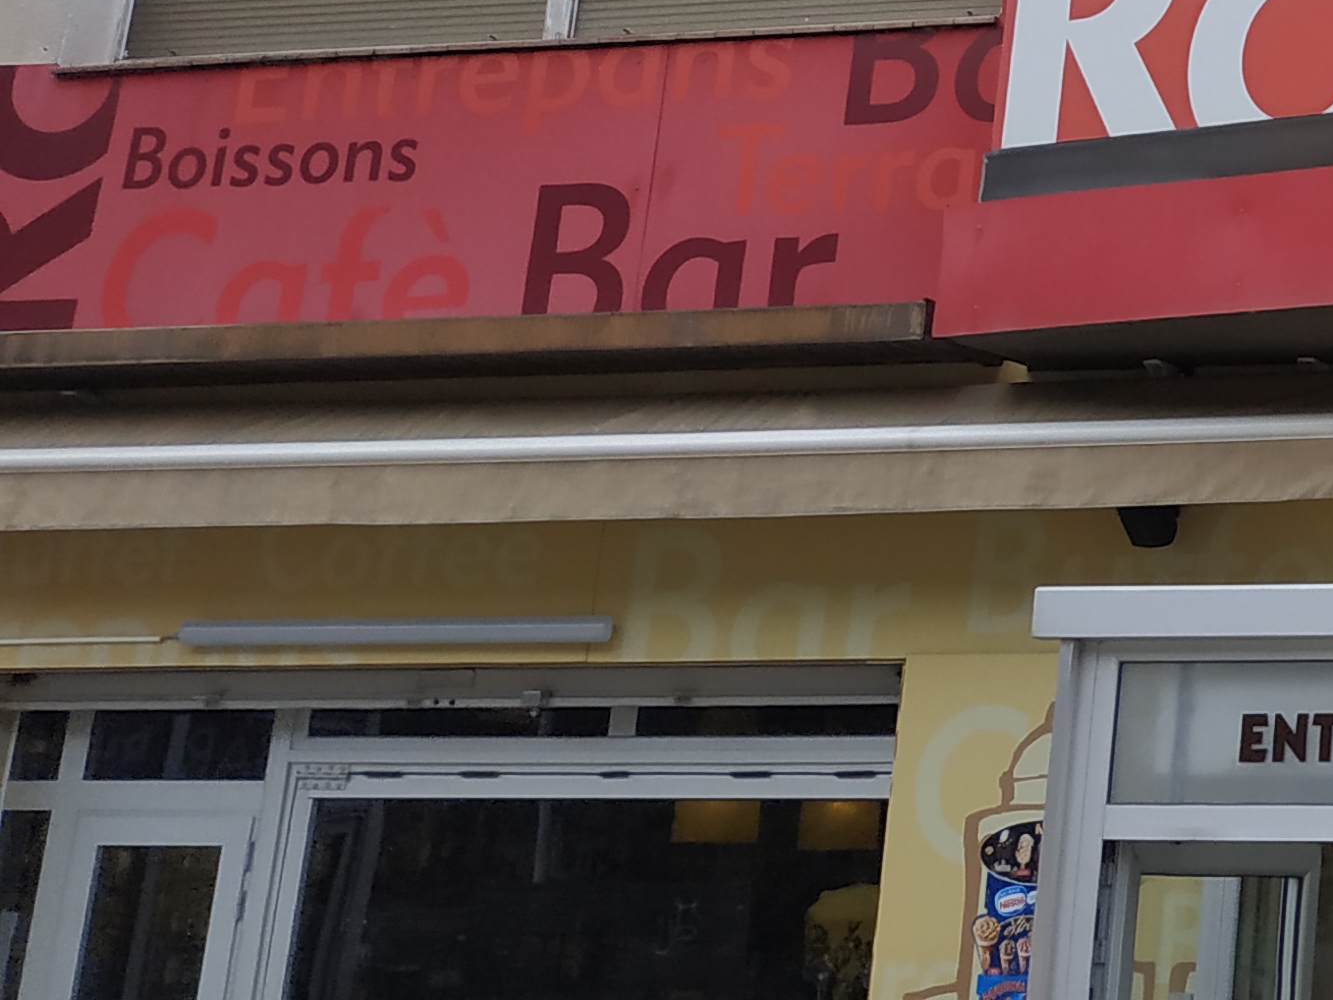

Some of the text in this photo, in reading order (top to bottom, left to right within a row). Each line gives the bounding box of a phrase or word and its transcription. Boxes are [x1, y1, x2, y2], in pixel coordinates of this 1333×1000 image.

[121, 125, 420, 192] Boissons
[100, 203, 471, 328] Cafè
[520, 182, 839, 316] Bar
[620, 523, 913, 660] Bar
